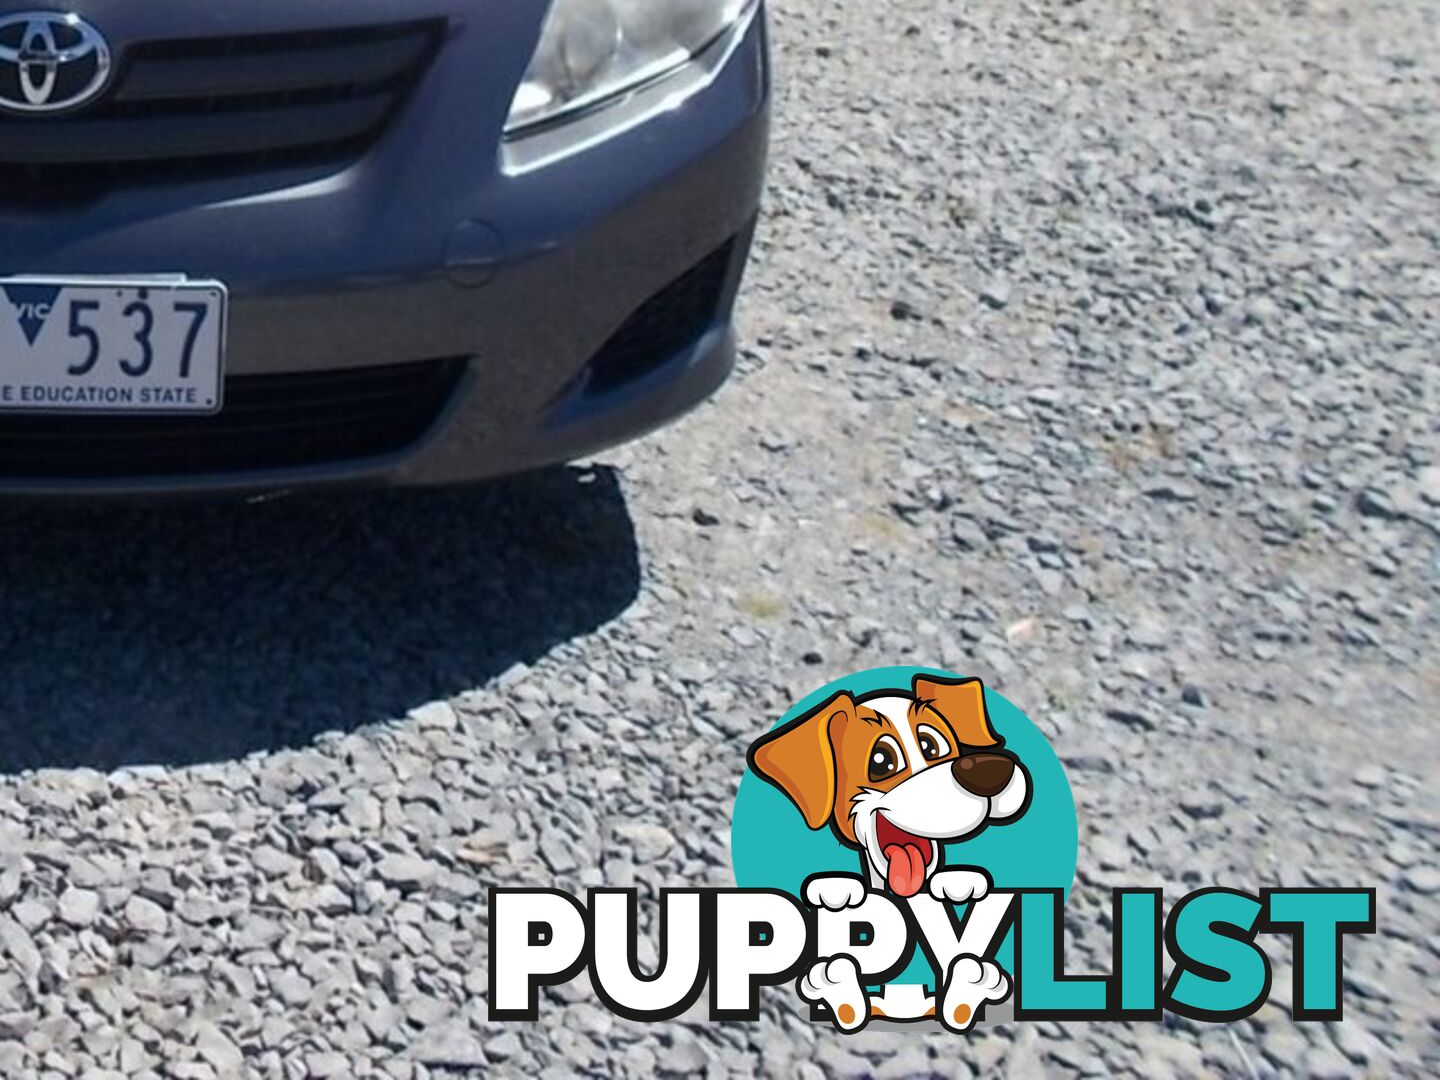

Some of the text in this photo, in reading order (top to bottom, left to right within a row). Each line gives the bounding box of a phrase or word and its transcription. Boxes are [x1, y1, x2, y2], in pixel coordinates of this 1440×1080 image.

[67, 299, 209, 378] 537
[20, 386, 130, 403] EDUCATION
[140, 387, 198, 403] STATE
